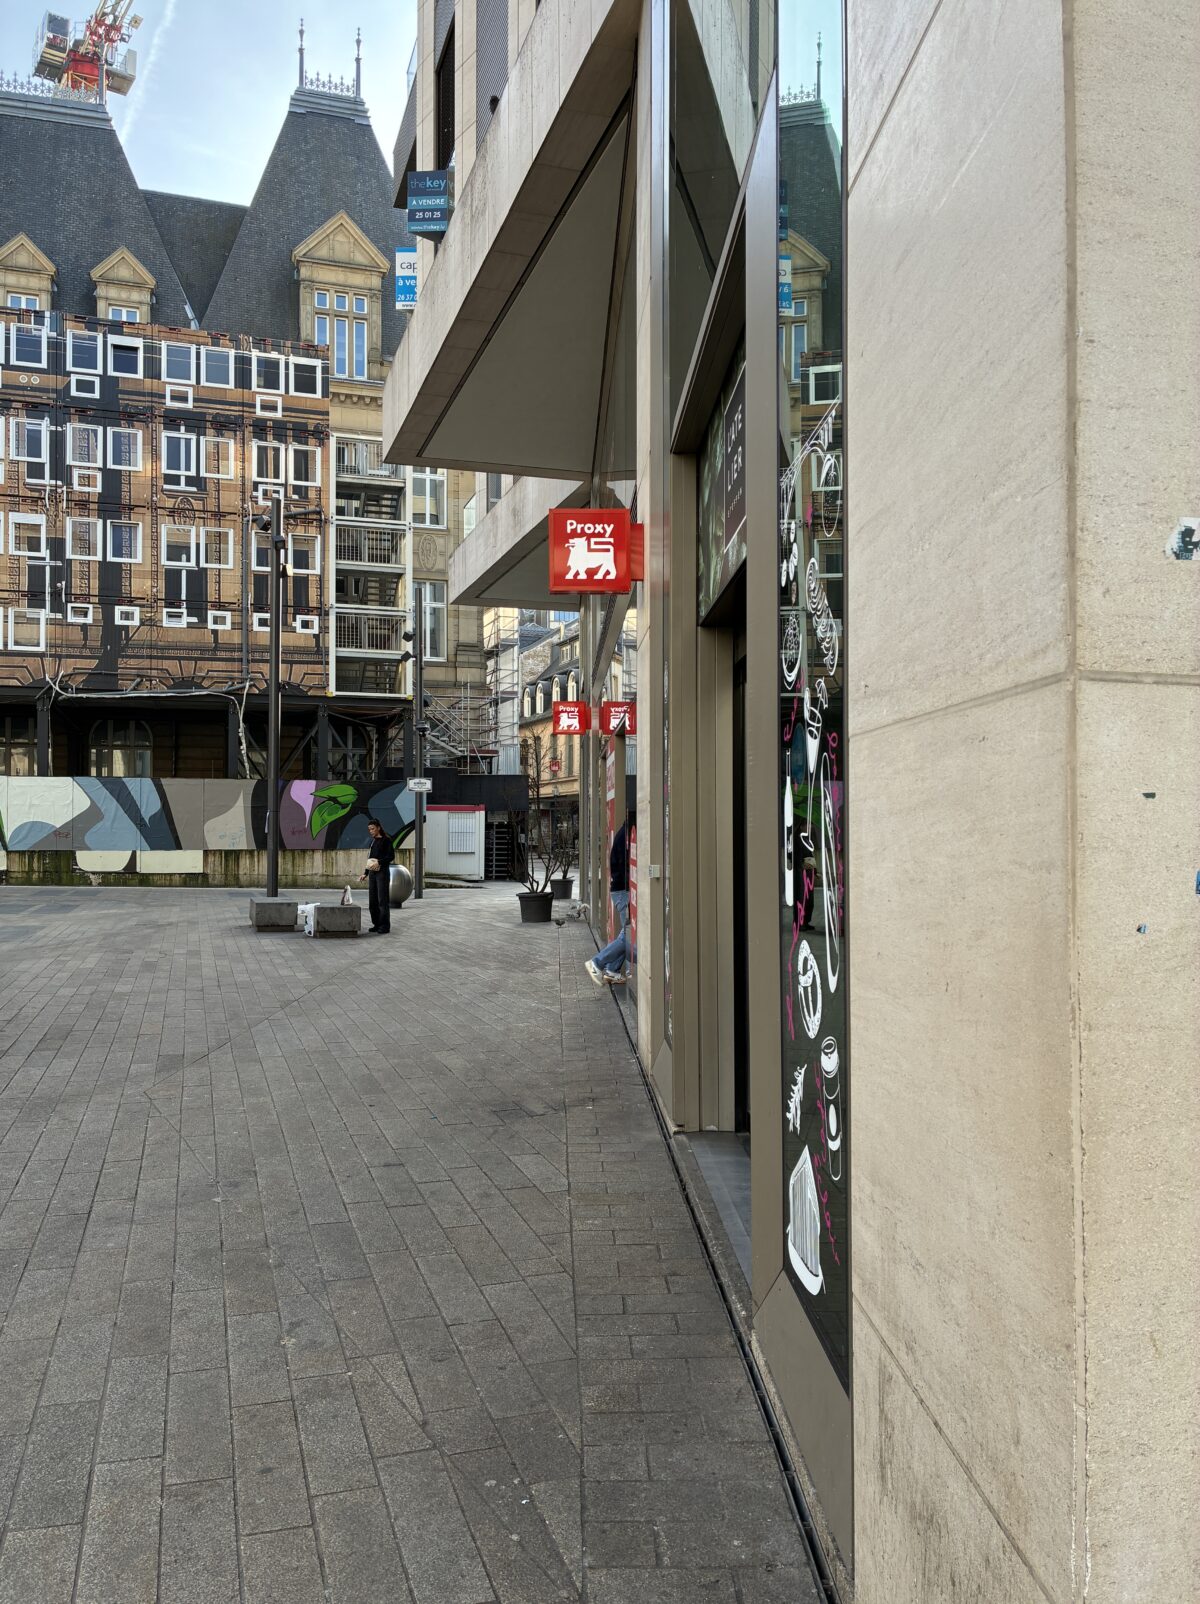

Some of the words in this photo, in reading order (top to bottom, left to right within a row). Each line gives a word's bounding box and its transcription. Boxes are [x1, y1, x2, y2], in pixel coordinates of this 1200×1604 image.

[418, 198, 445, 206] VENDRE
[727, 445, 742, 492] LIER
[566, 519, 615, 538] Proxy
[558, 705, 579, 713] Proxy
